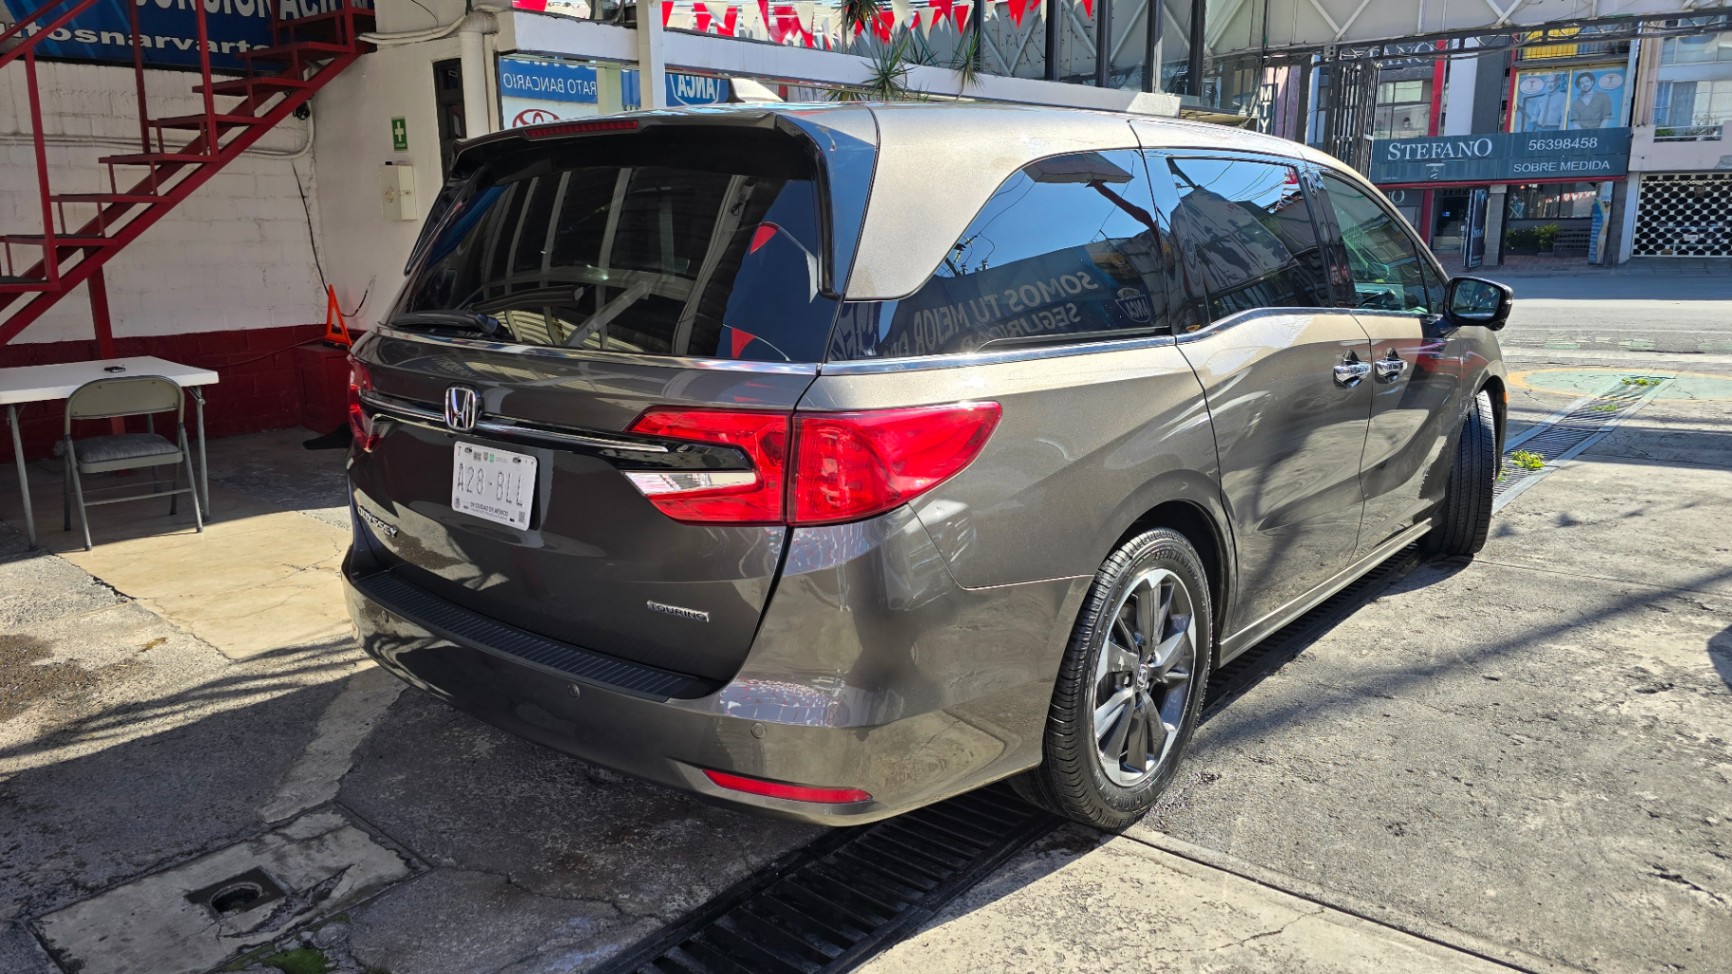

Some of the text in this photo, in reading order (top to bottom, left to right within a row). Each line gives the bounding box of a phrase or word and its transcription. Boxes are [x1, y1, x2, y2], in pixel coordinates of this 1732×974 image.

[1387, 137, 1598, 161] STEFANO 56398458
[1513, 160, 1610, 173] SOBRE MEDIDA
[648, 600, 708, 622] TOURING
